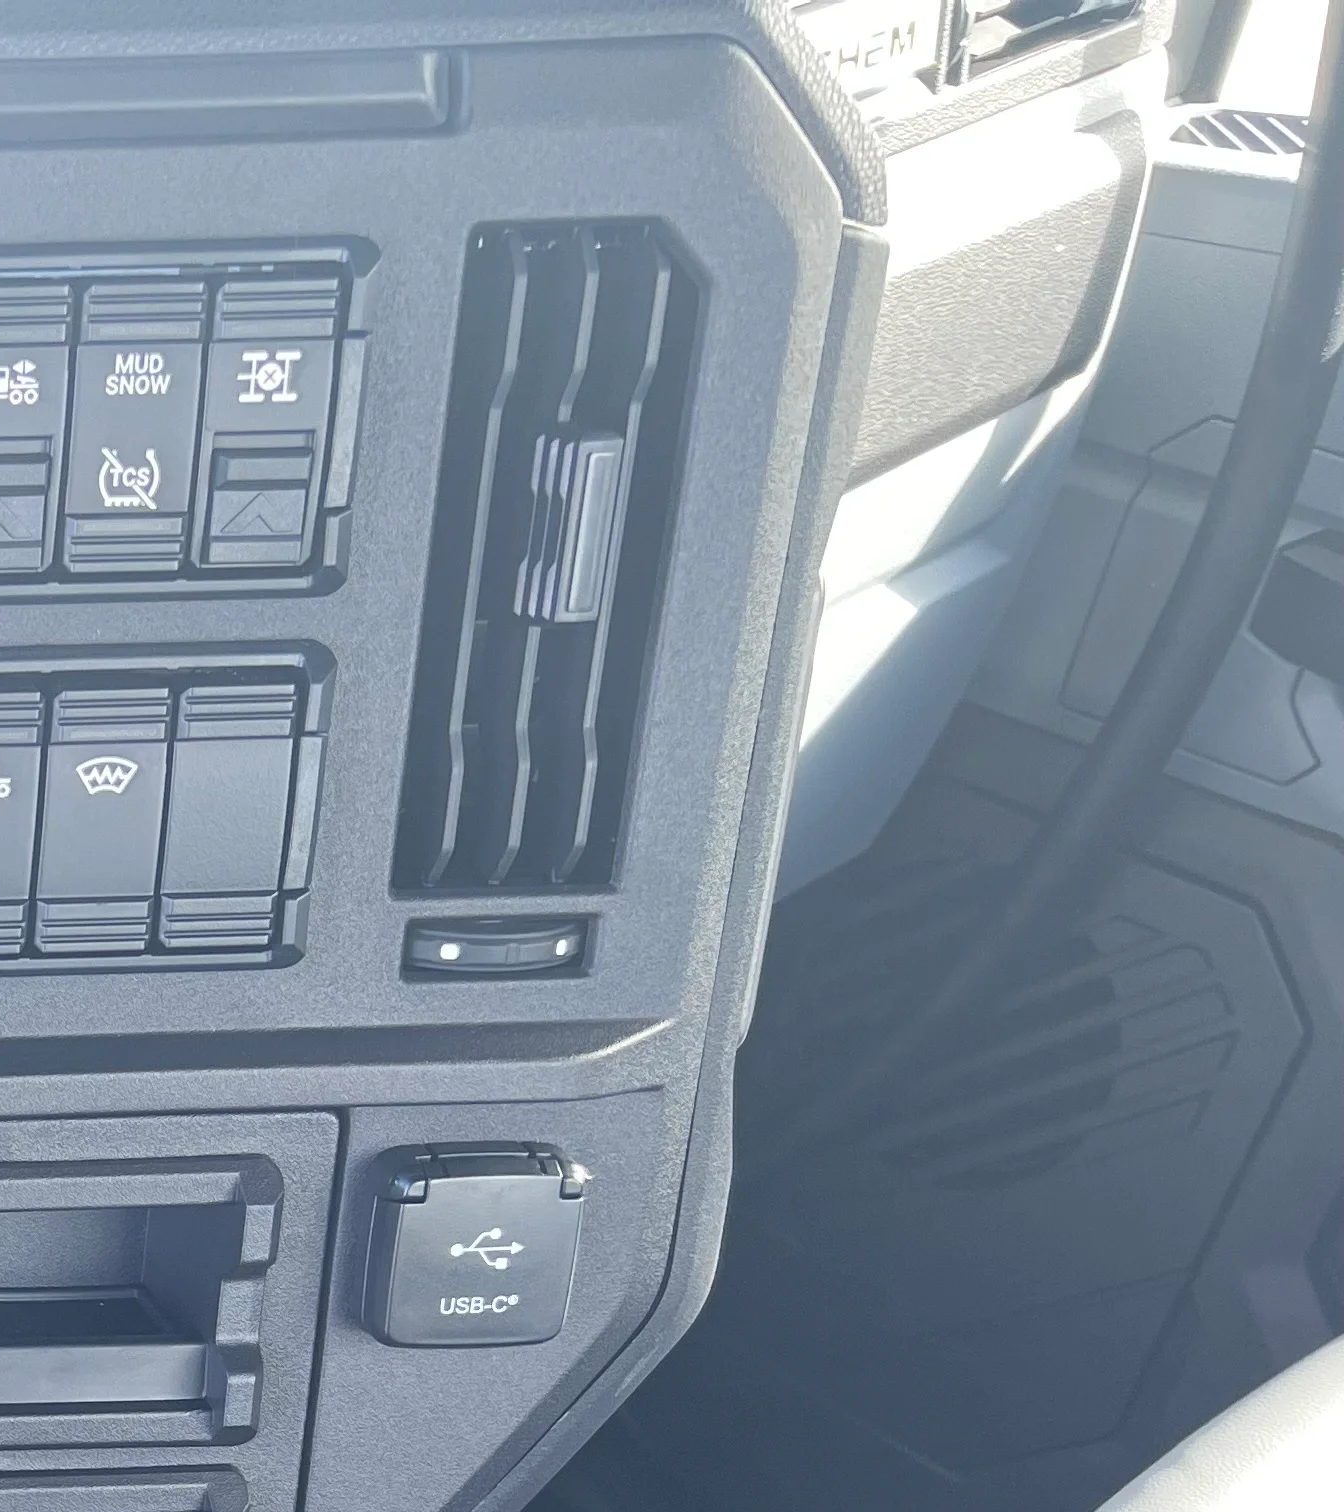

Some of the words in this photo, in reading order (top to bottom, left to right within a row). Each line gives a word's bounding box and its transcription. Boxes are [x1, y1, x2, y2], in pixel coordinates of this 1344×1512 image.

[114, 353, 164, 374] MUD
[105, 374, 172, 396] SNOW
[109, 466, 151, 488] TCS
